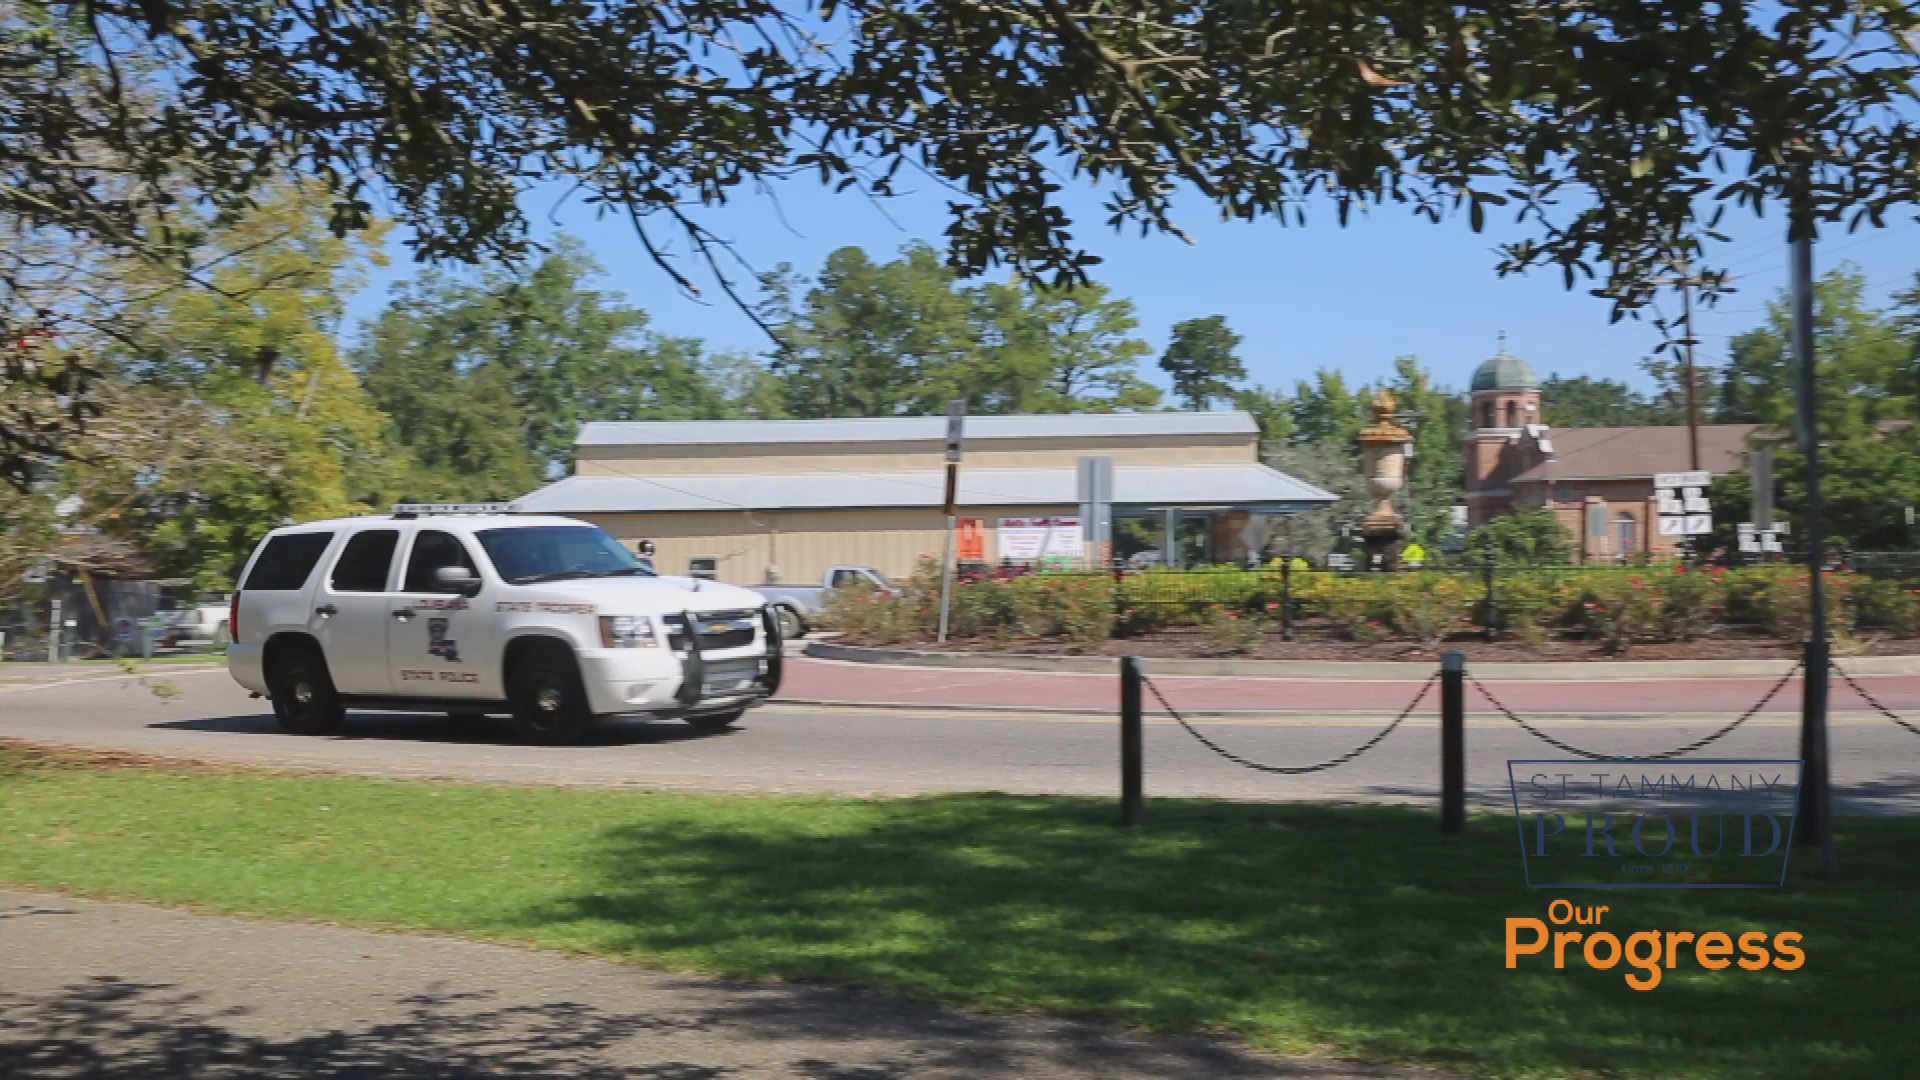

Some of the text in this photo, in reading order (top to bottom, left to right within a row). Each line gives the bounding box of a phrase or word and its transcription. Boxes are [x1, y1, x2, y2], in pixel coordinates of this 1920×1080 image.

[496, 601, 532, 613] STATE
[401, 669, 479, 684] STATE POLICE
